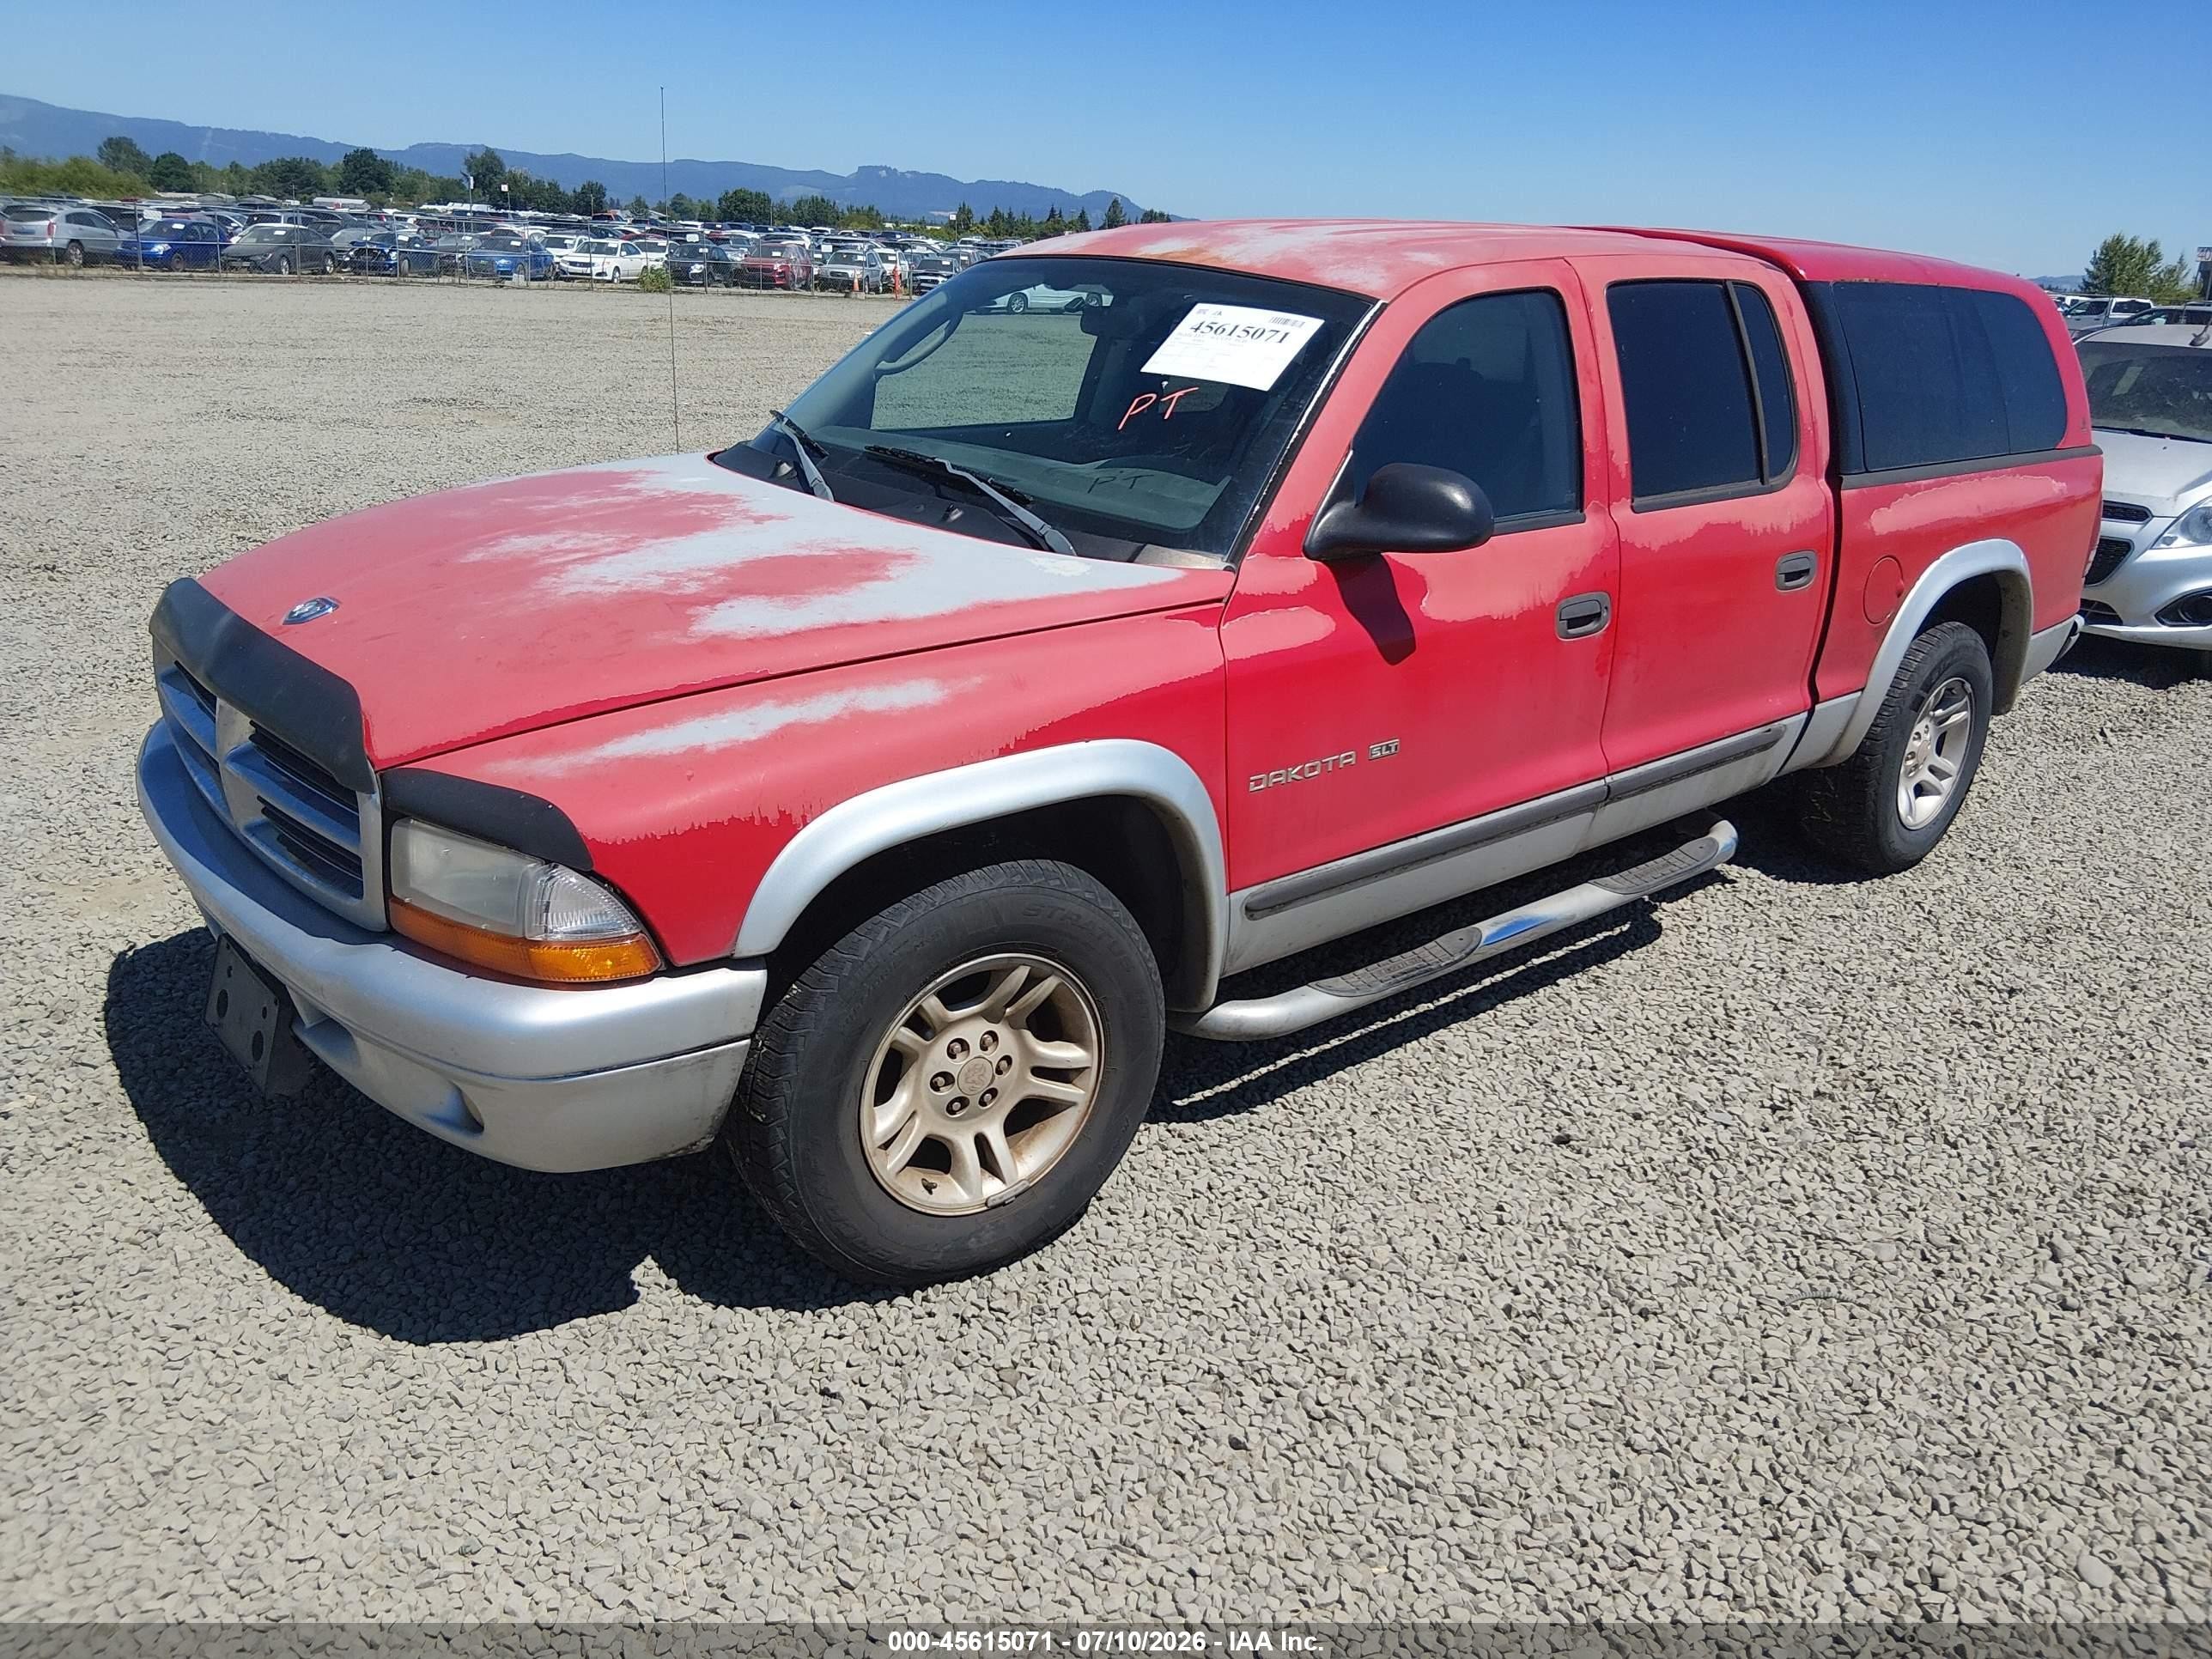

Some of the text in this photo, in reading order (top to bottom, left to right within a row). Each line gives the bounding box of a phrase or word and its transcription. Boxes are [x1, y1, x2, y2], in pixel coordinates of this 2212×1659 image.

[1189, 320, 1291, 344] 45615071
[1117, 386, 1200, 431] PT
[1249, 739, 1400, 793] DAKOTA SLT
